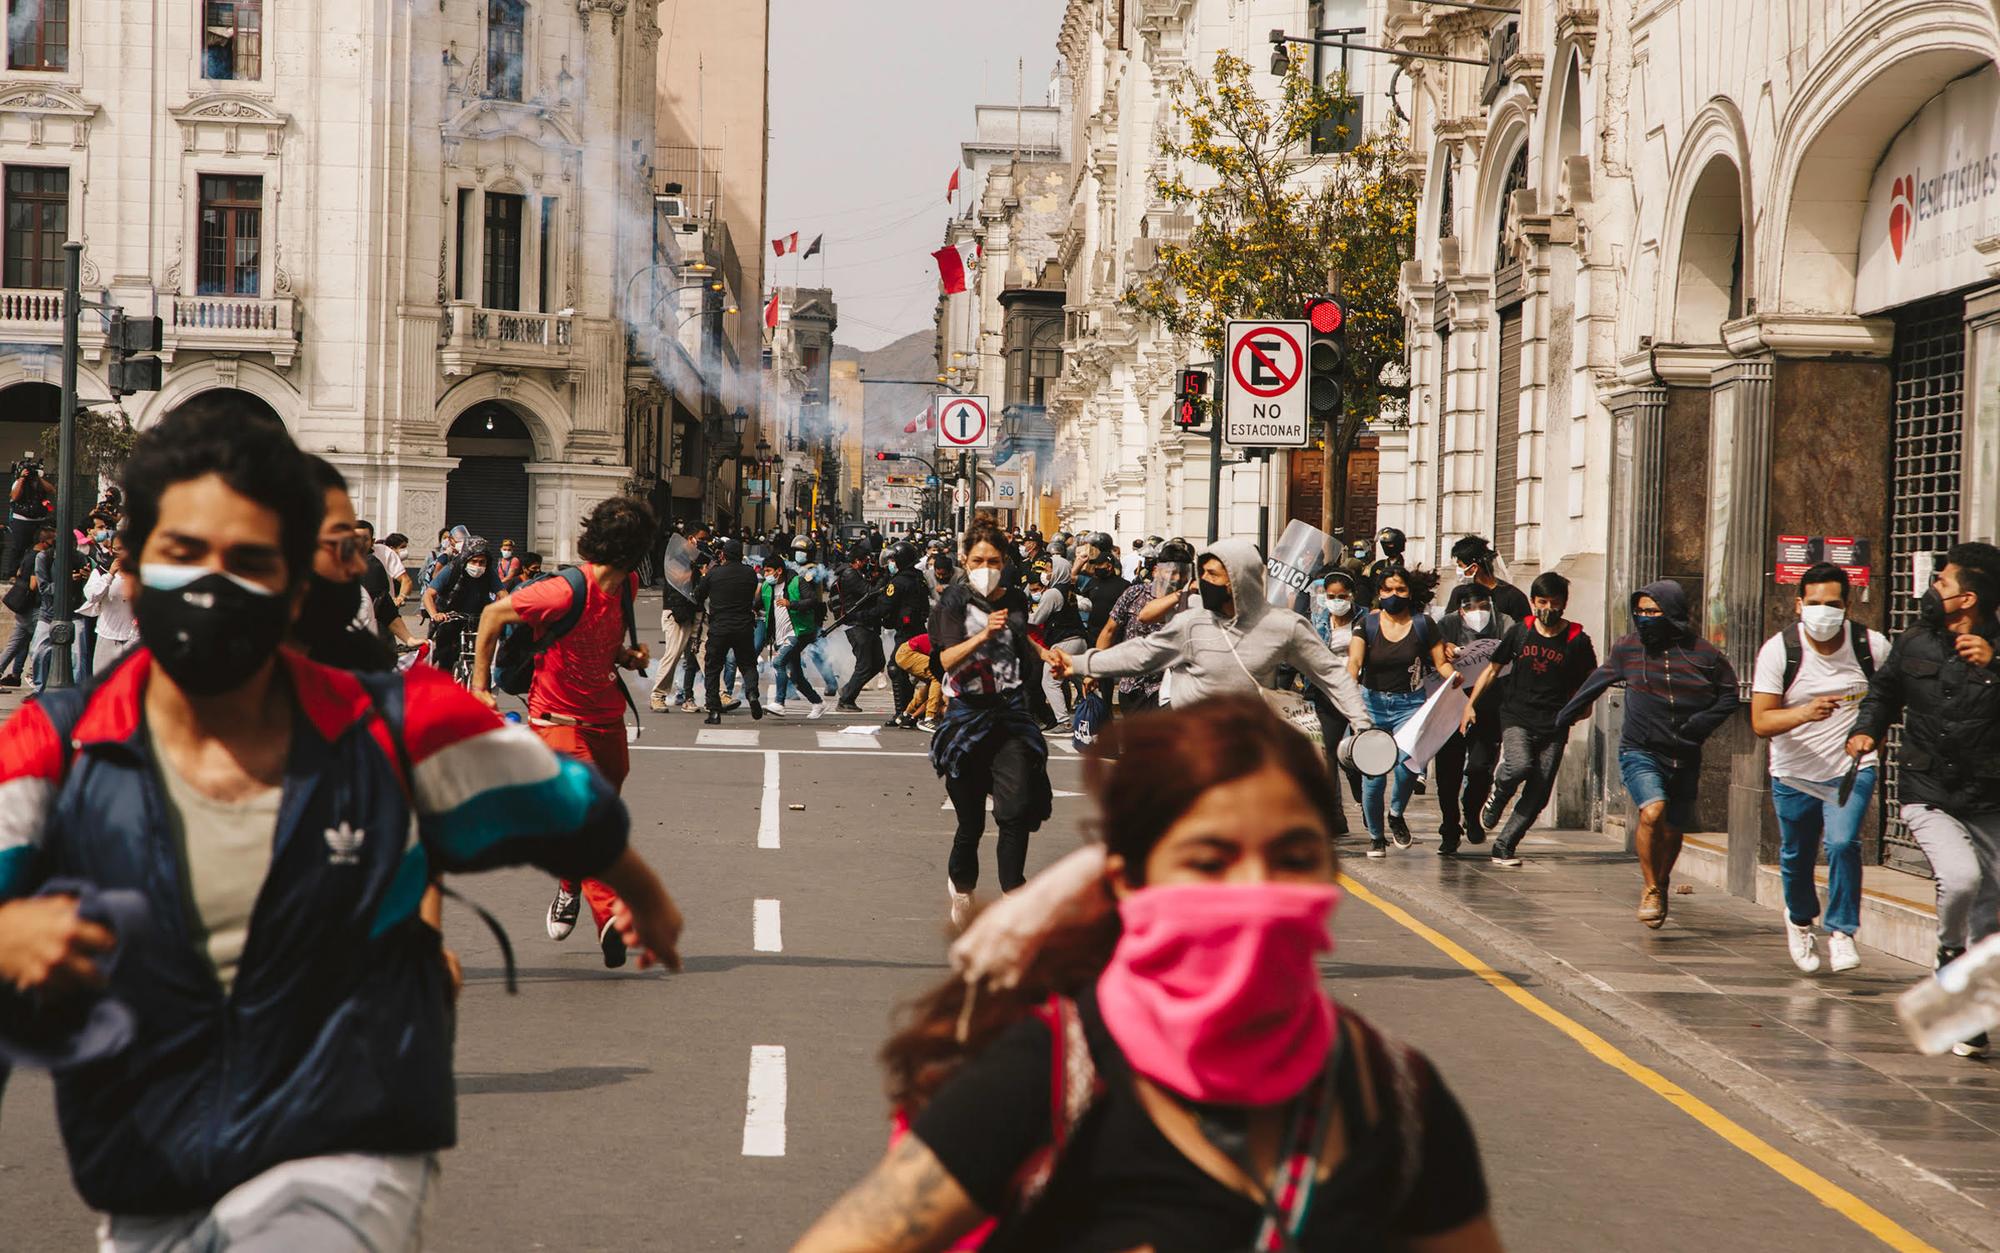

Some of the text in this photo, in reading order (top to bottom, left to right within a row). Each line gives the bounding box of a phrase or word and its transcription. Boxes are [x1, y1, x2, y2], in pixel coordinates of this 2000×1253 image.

[1912, 149, 1981, 239] Jesucristo
[1251, 342, 1280, 385] E
[1185, 375, 1199, 394] 15
[1253, 403, 1281, 419] NO
[1231, 423, 1301, 437] ESTACIONAR
[999, 485, 1014, 497] 30
[1519, 645, 1538, 659] OO
[1540, 646, 1565, 664] YOR
